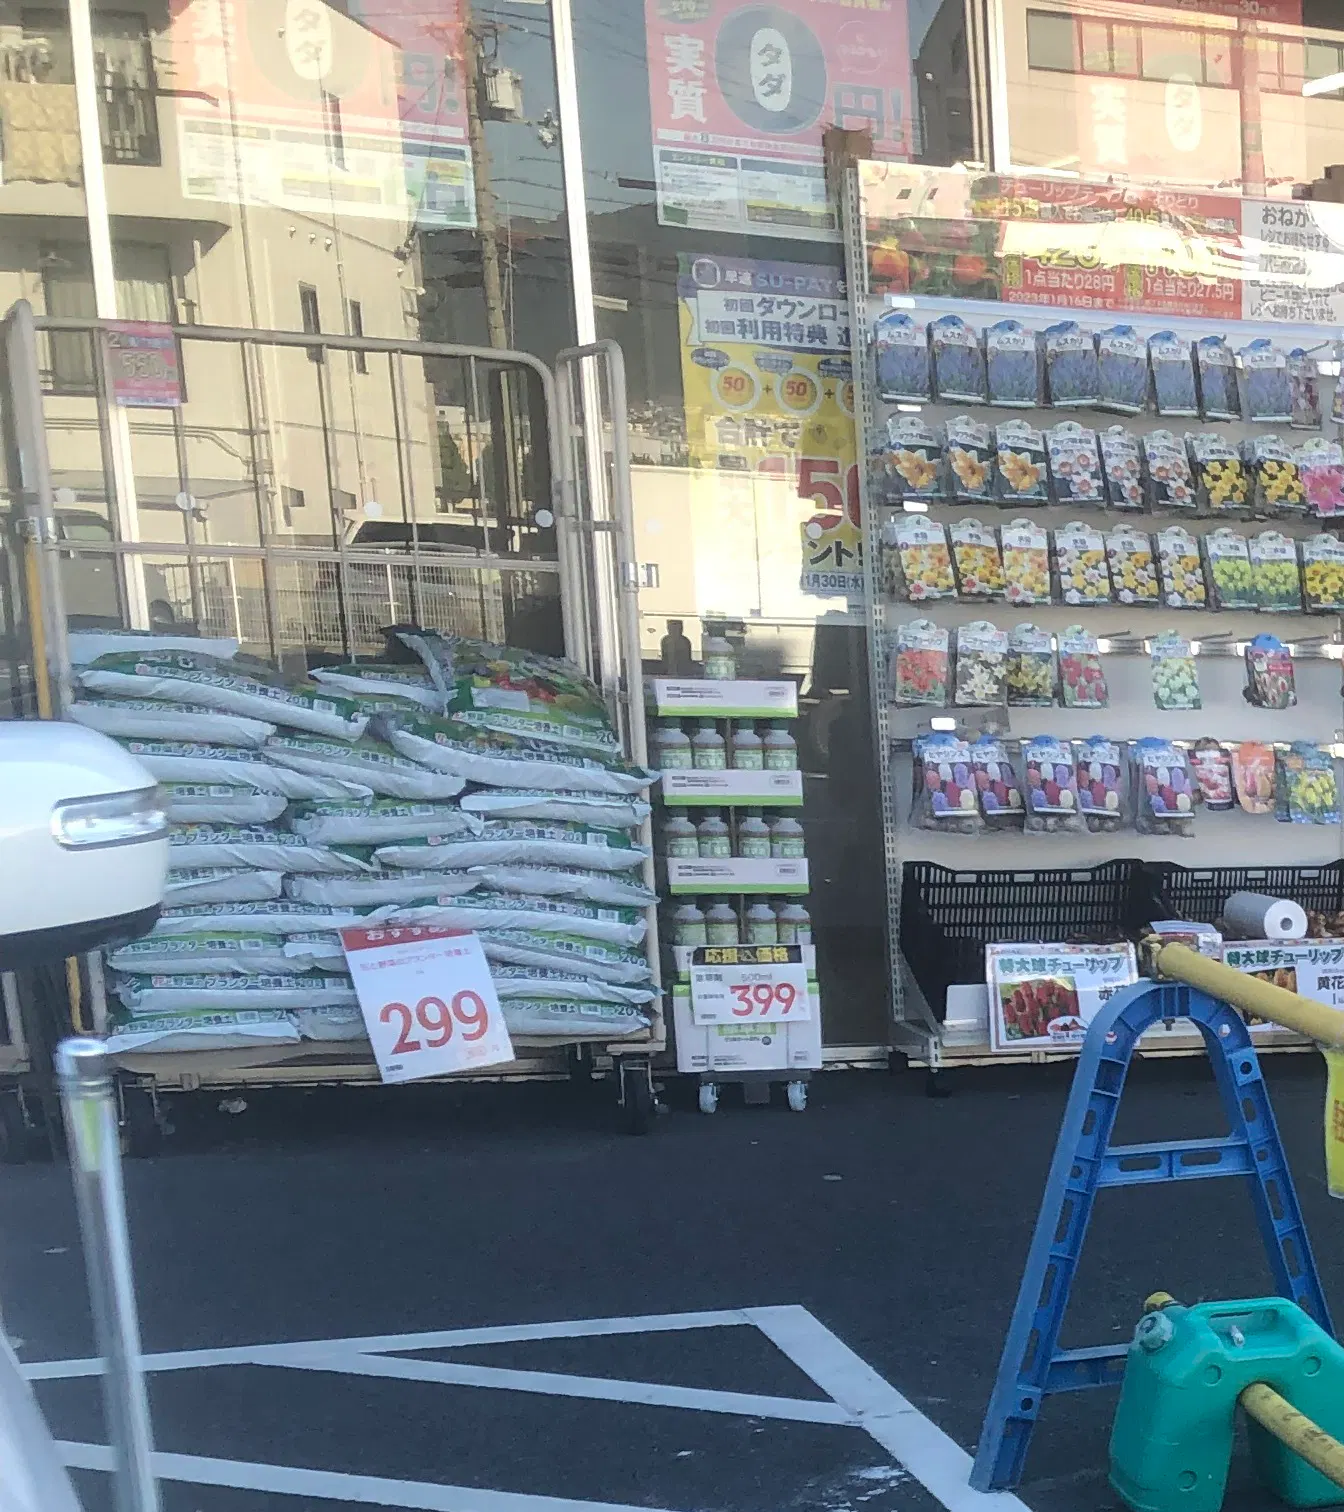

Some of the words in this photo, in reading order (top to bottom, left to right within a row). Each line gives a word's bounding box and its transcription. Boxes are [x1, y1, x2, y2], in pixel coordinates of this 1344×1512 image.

[664, 33, 708, 123] 実質
[757, 42, 787, 98] タダ
[1025, 268, 1115, 292] 1点当たり28円
[1145, 276, 1235, 301] 1点当たり27.5円
[724, 375, 746, 392] 50
[786, 381, 808, 398] 50
[729, 982, 796, 1017] 399
[379, 989, 489, 1056] 299
